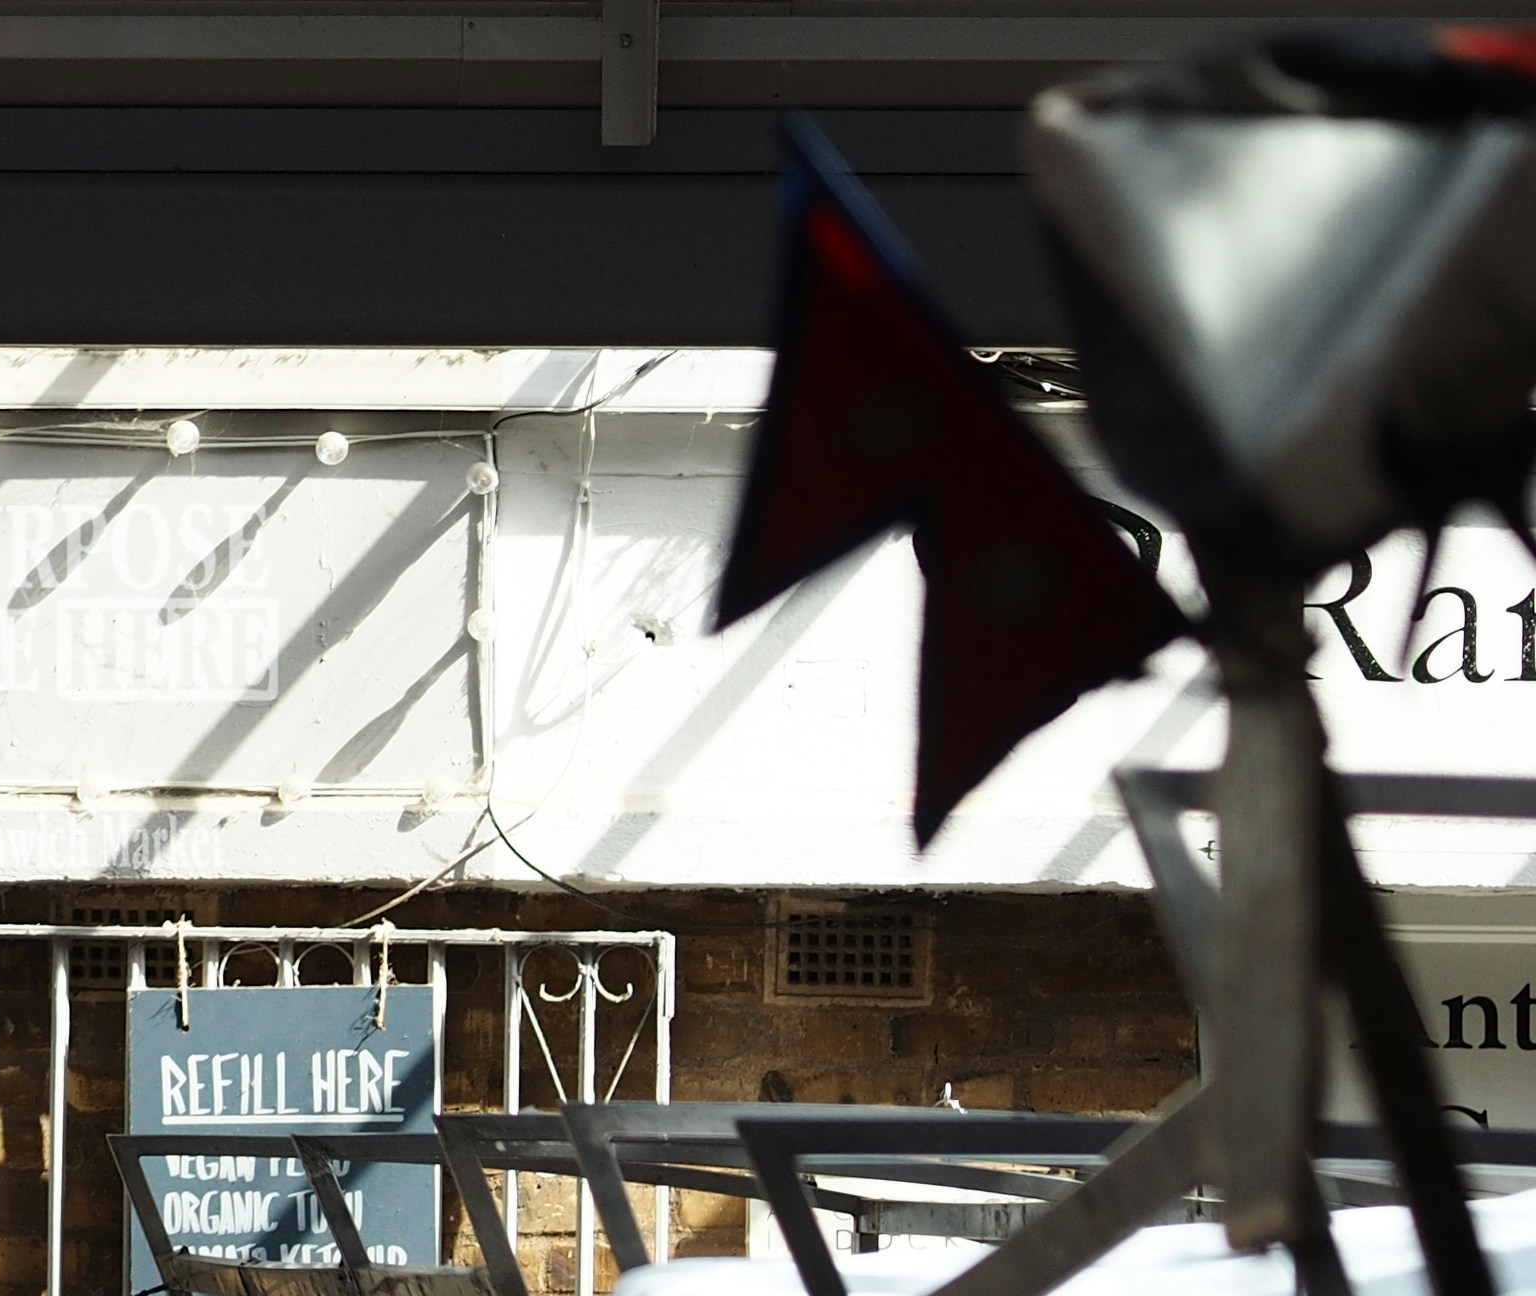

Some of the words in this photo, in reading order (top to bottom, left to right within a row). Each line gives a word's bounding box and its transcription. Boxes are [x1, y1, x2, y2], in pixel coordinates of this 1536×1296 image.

[62, 606, 273, 694] HERE
[99, 811, 225, 871] Market
[161, 1051, 300, 1116] REFILL
[311, 1048, 410, 1114] HERE
[163, 1191, 281, 1235] ORGANIC
[287, 1189, 364, 1233] TOU
